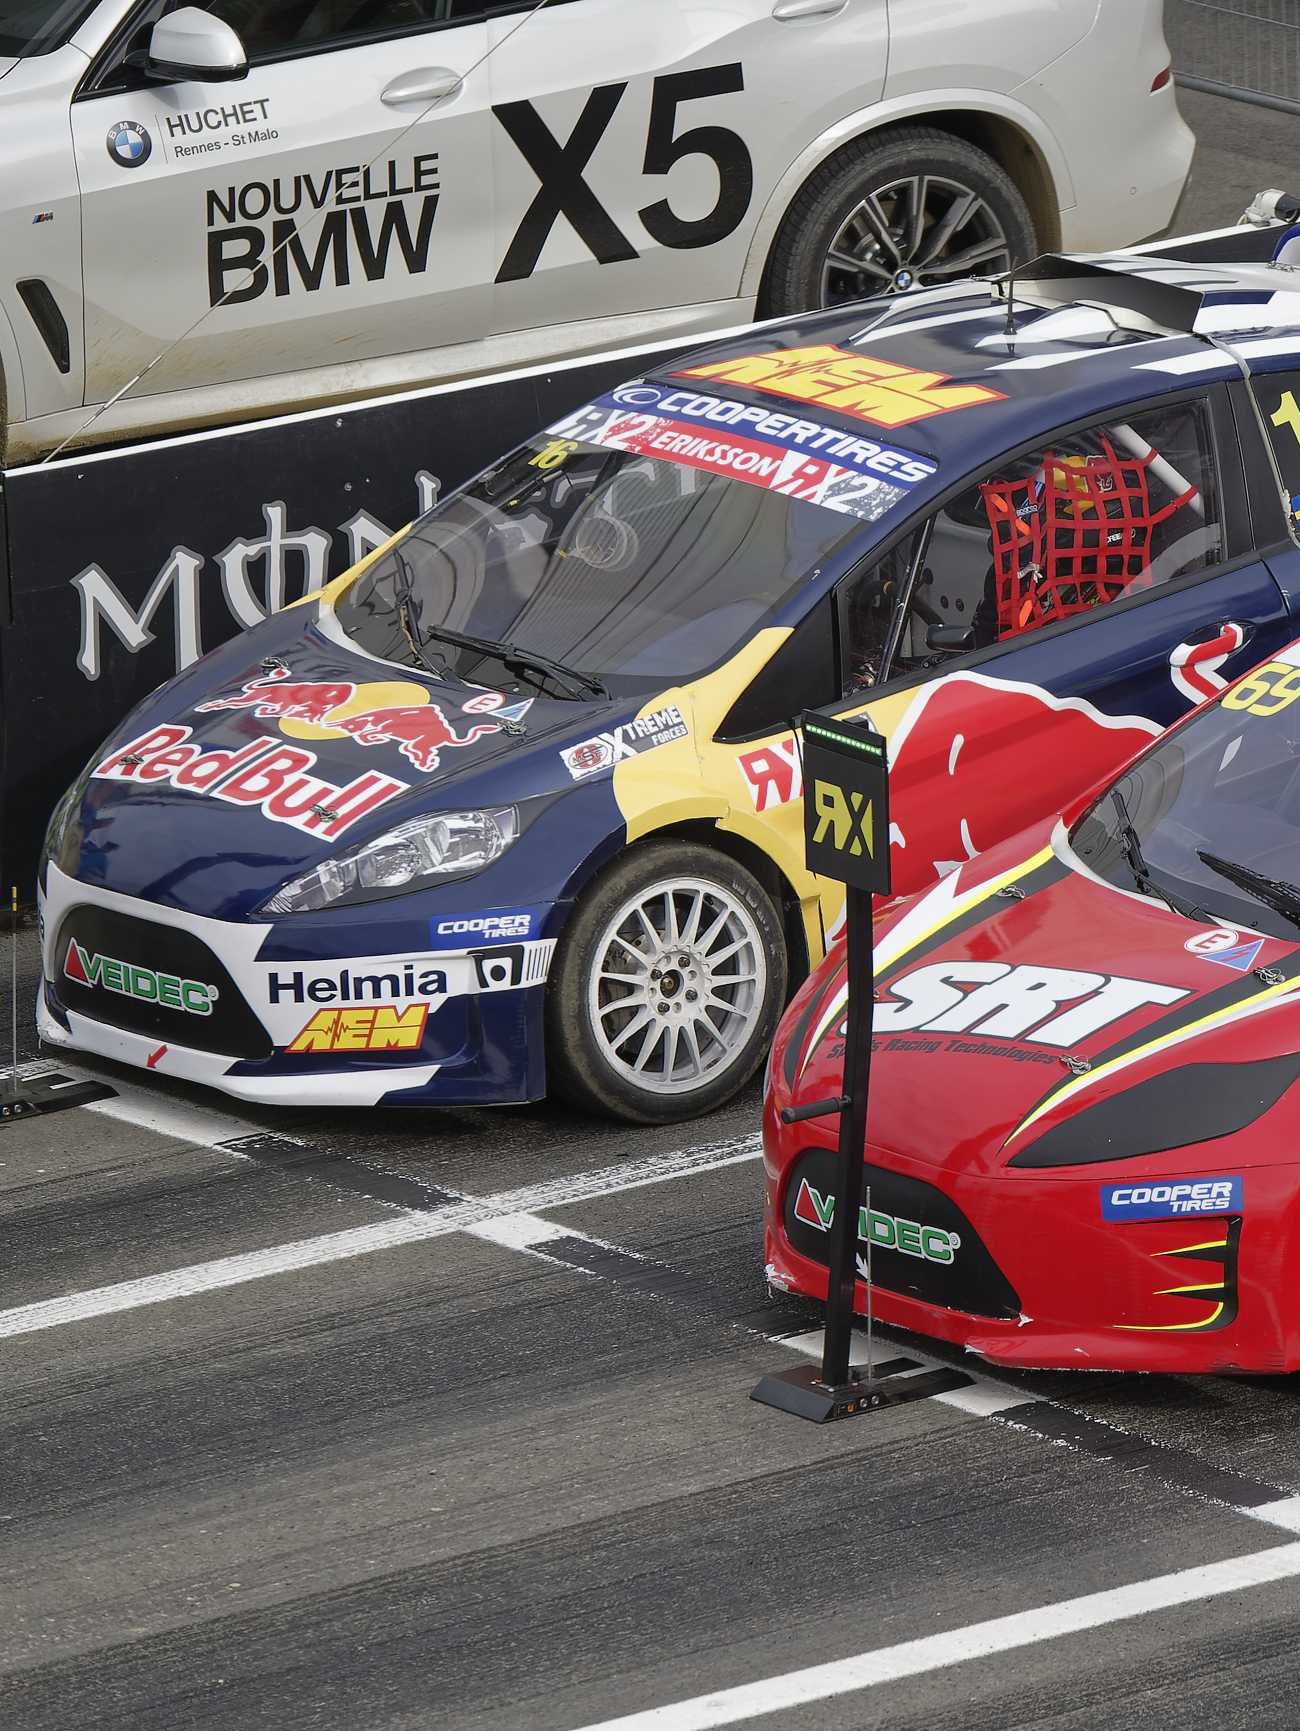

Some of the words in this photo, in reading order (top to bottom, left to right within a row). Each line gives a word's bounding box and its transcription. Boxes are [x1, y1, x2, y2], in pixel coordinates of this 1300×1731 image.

[165, 98, 270, 138] HUCHET
[174, 141, 220, 158] Rennes
[232, 133, 248, 148] St
[250, 128, 279, 145] Malo
[206, 153, 441, 227] NOUVELLE
[491, 61, 754, 284] X5
[207, 194, 440, 307] BMW
[528, 438, 578, 469] 16
[650, 430, 783, 478] ERIKSSON
[656, 392, 938, 484] COOPERTIRES
[598, 705, 682, 763] XTREME
[651, 724, 689, 746] FORCES
[437, 914, 532, 936] COOPER
[483, 926, 529, 939] TIRES
[80, 947, 213, 1016] VEIDEC
[269, 965, 448, 1005] Helmia
[839, 960, 1199, 1050] SRT
[883, 1037, 943, 1054] Racing
[943, 1038, 1059, 1065] Technologies
[1111, 1181, 1233, 1206] COOPER
[1169, 1196, 1230, 1213] TIRES
[809, 1187, 955, 1264] VIDEC
